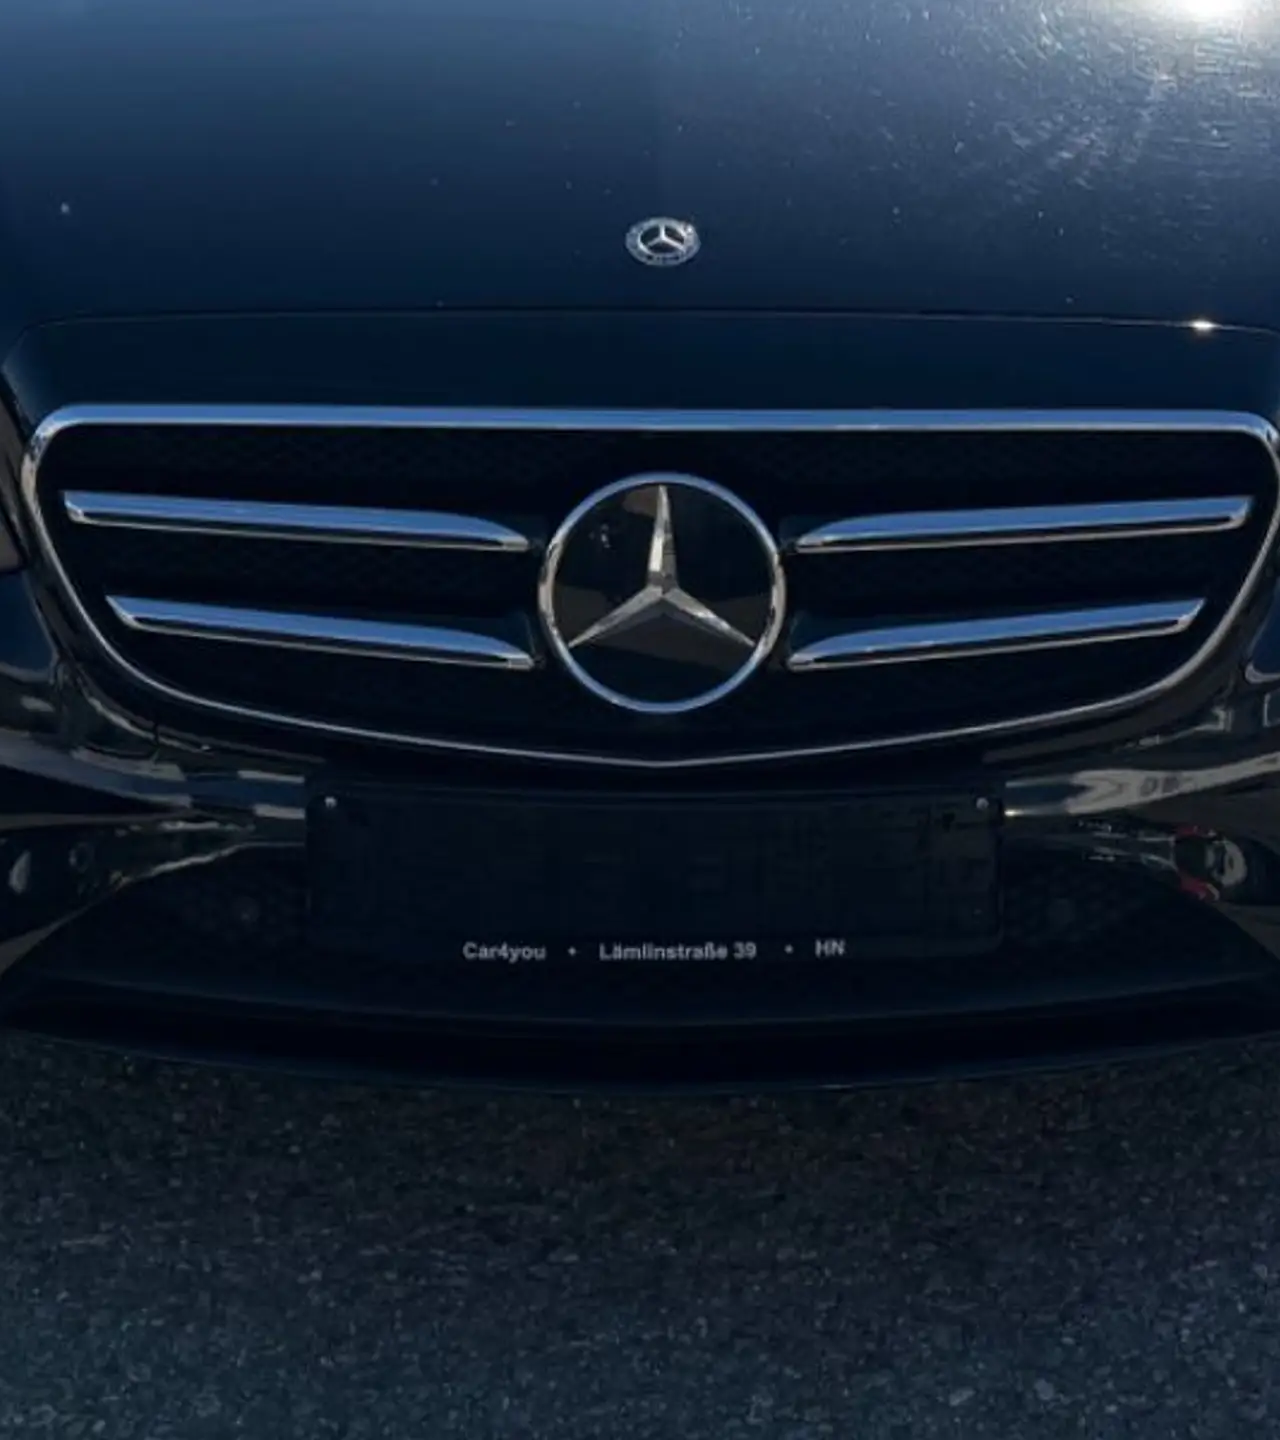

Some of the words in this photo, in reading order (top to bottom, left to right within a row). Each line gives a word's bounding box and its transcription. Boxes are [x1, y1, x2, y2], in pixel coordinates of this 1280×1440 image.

[462, 940, 547, 964] Car4you
[733, 940, 758, 960] 39
[814, 937, 847, 959] HN
